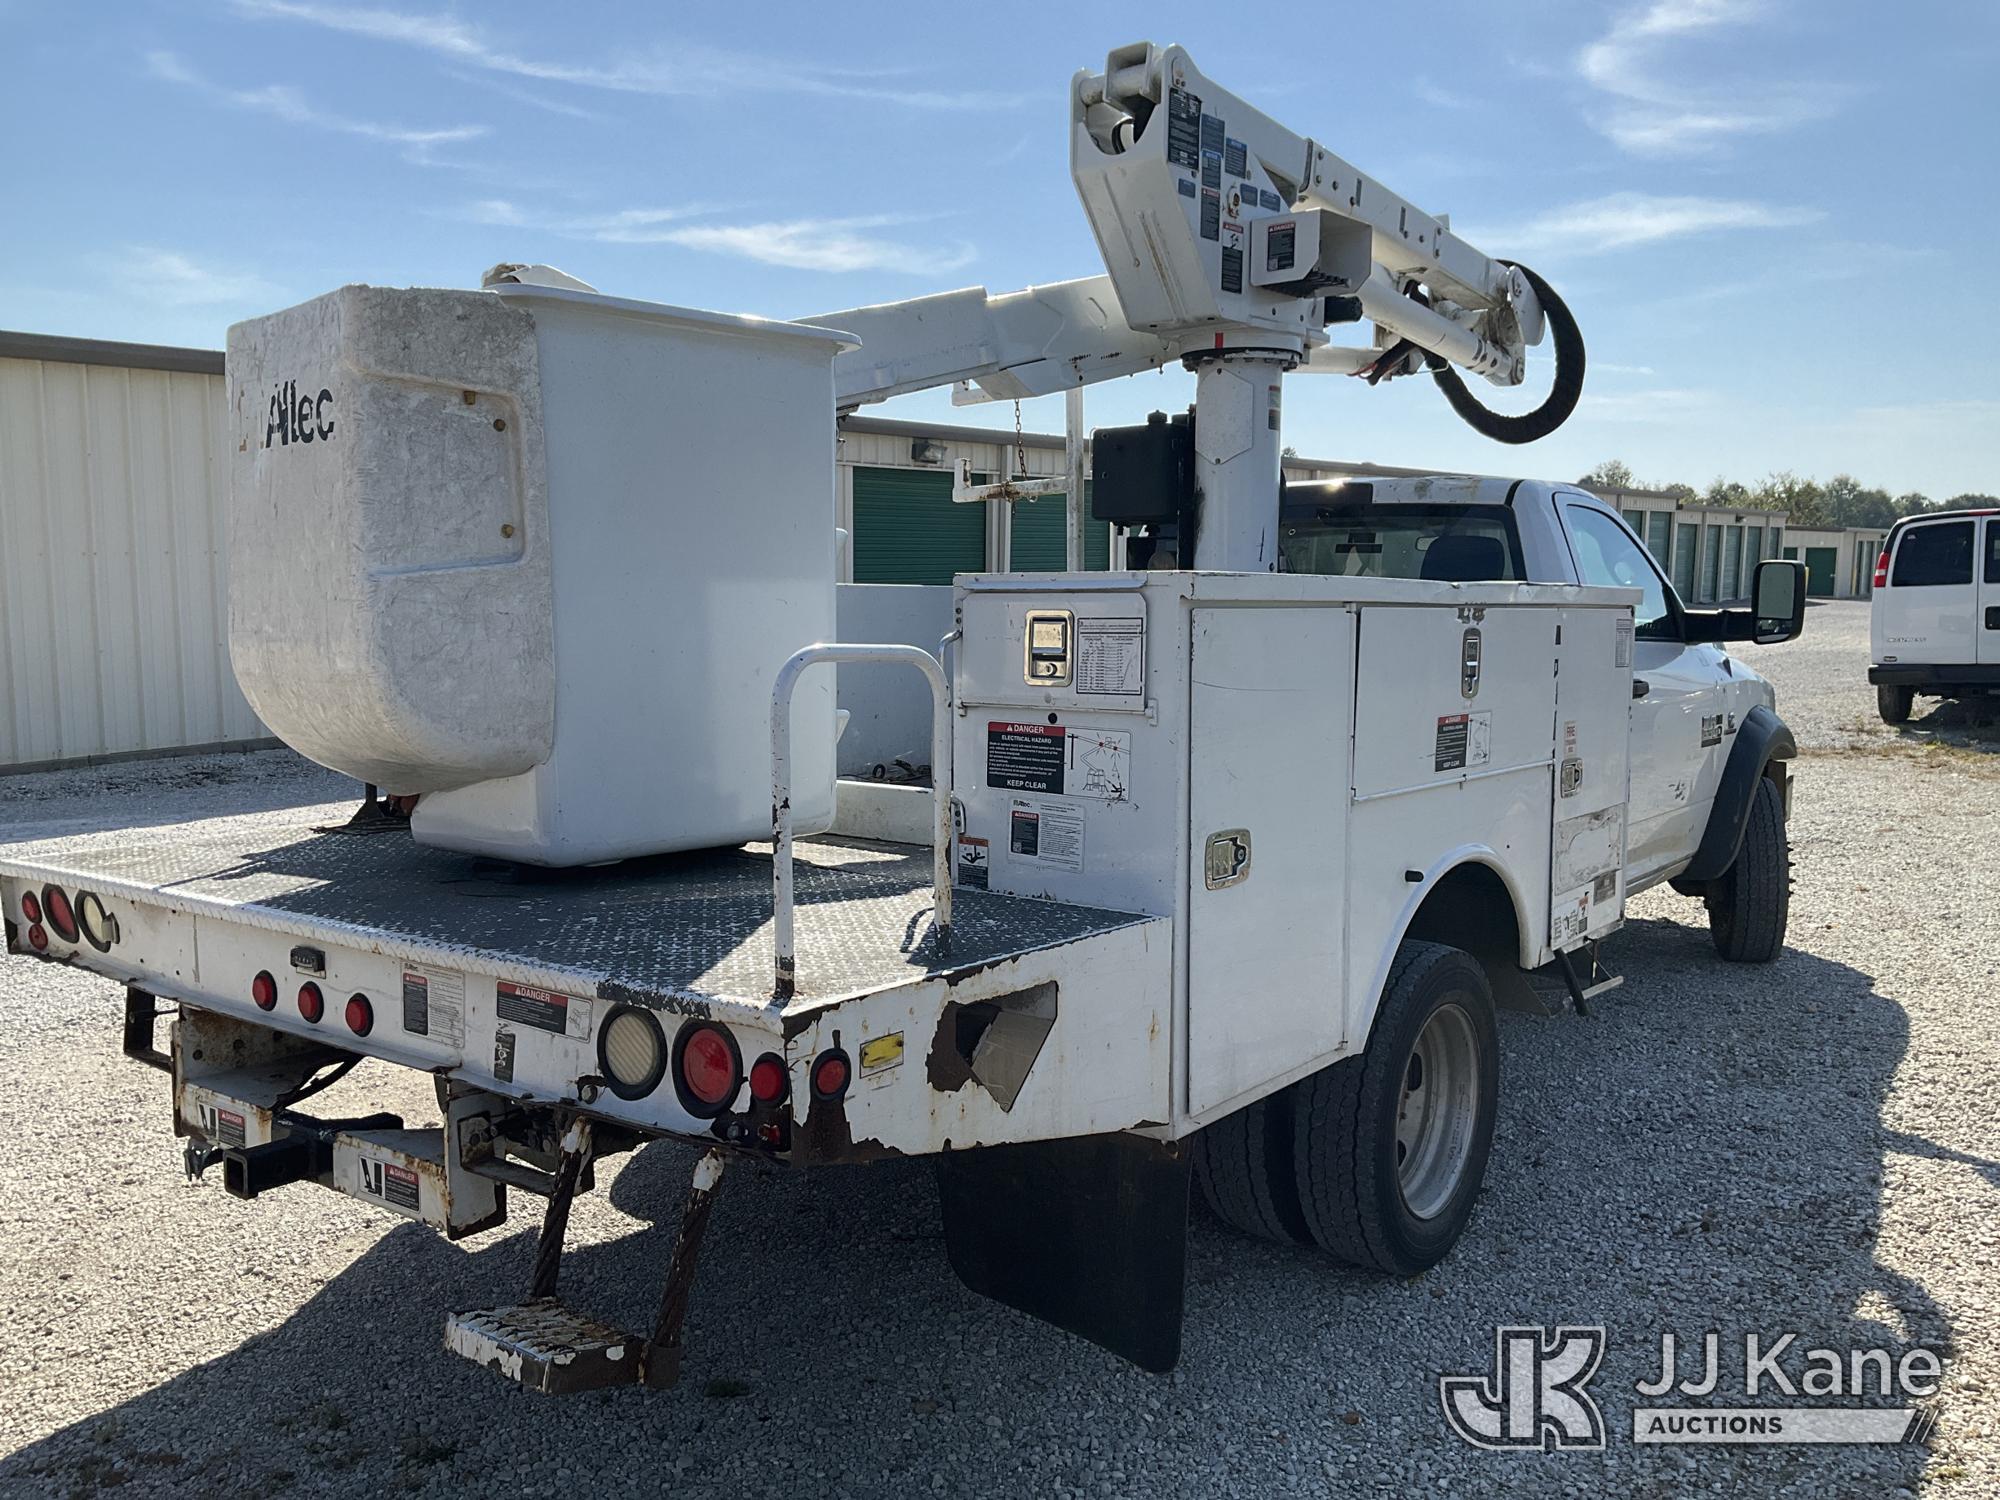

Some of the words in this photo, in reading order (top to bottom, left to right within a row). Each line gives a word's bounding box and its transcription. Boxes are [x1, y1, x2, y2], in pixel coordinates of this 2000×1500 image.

[1013, 725, 1045, 734] DANGER
[1006, 779, 1024, 787] KEEP
[1024, 781, 1047, 790] CLEAR
[520, 988, 550, 1002] DANGER
[394, 1168, 415, 1181] DANGER
